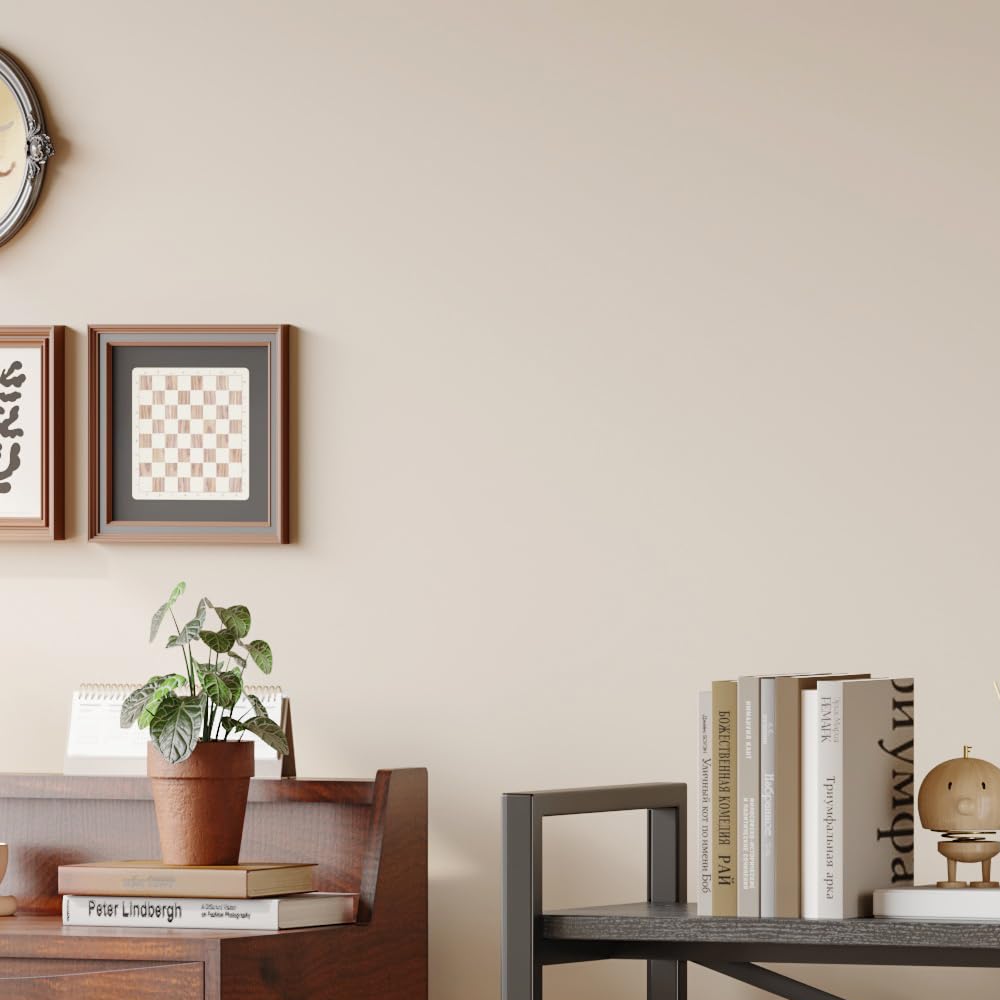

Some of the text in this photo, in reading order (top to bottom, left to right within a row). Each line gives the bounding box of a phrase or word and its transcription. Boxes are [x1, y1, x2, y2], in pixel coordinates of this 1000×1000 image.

[702, 758, 712, 803] Уличный
[718, 711, 735, 886] БОЖЕСТВЕННАЯ КОМЕДИЯ РАЙ
[702, 825, 708, 838] по
[823, 776, 836, 900] Триумфальная арка
[702, 874, 712, 894] Боб
[88, 900, 119, 918] Peter
[122, 901, 182, 923] Lindbergh
